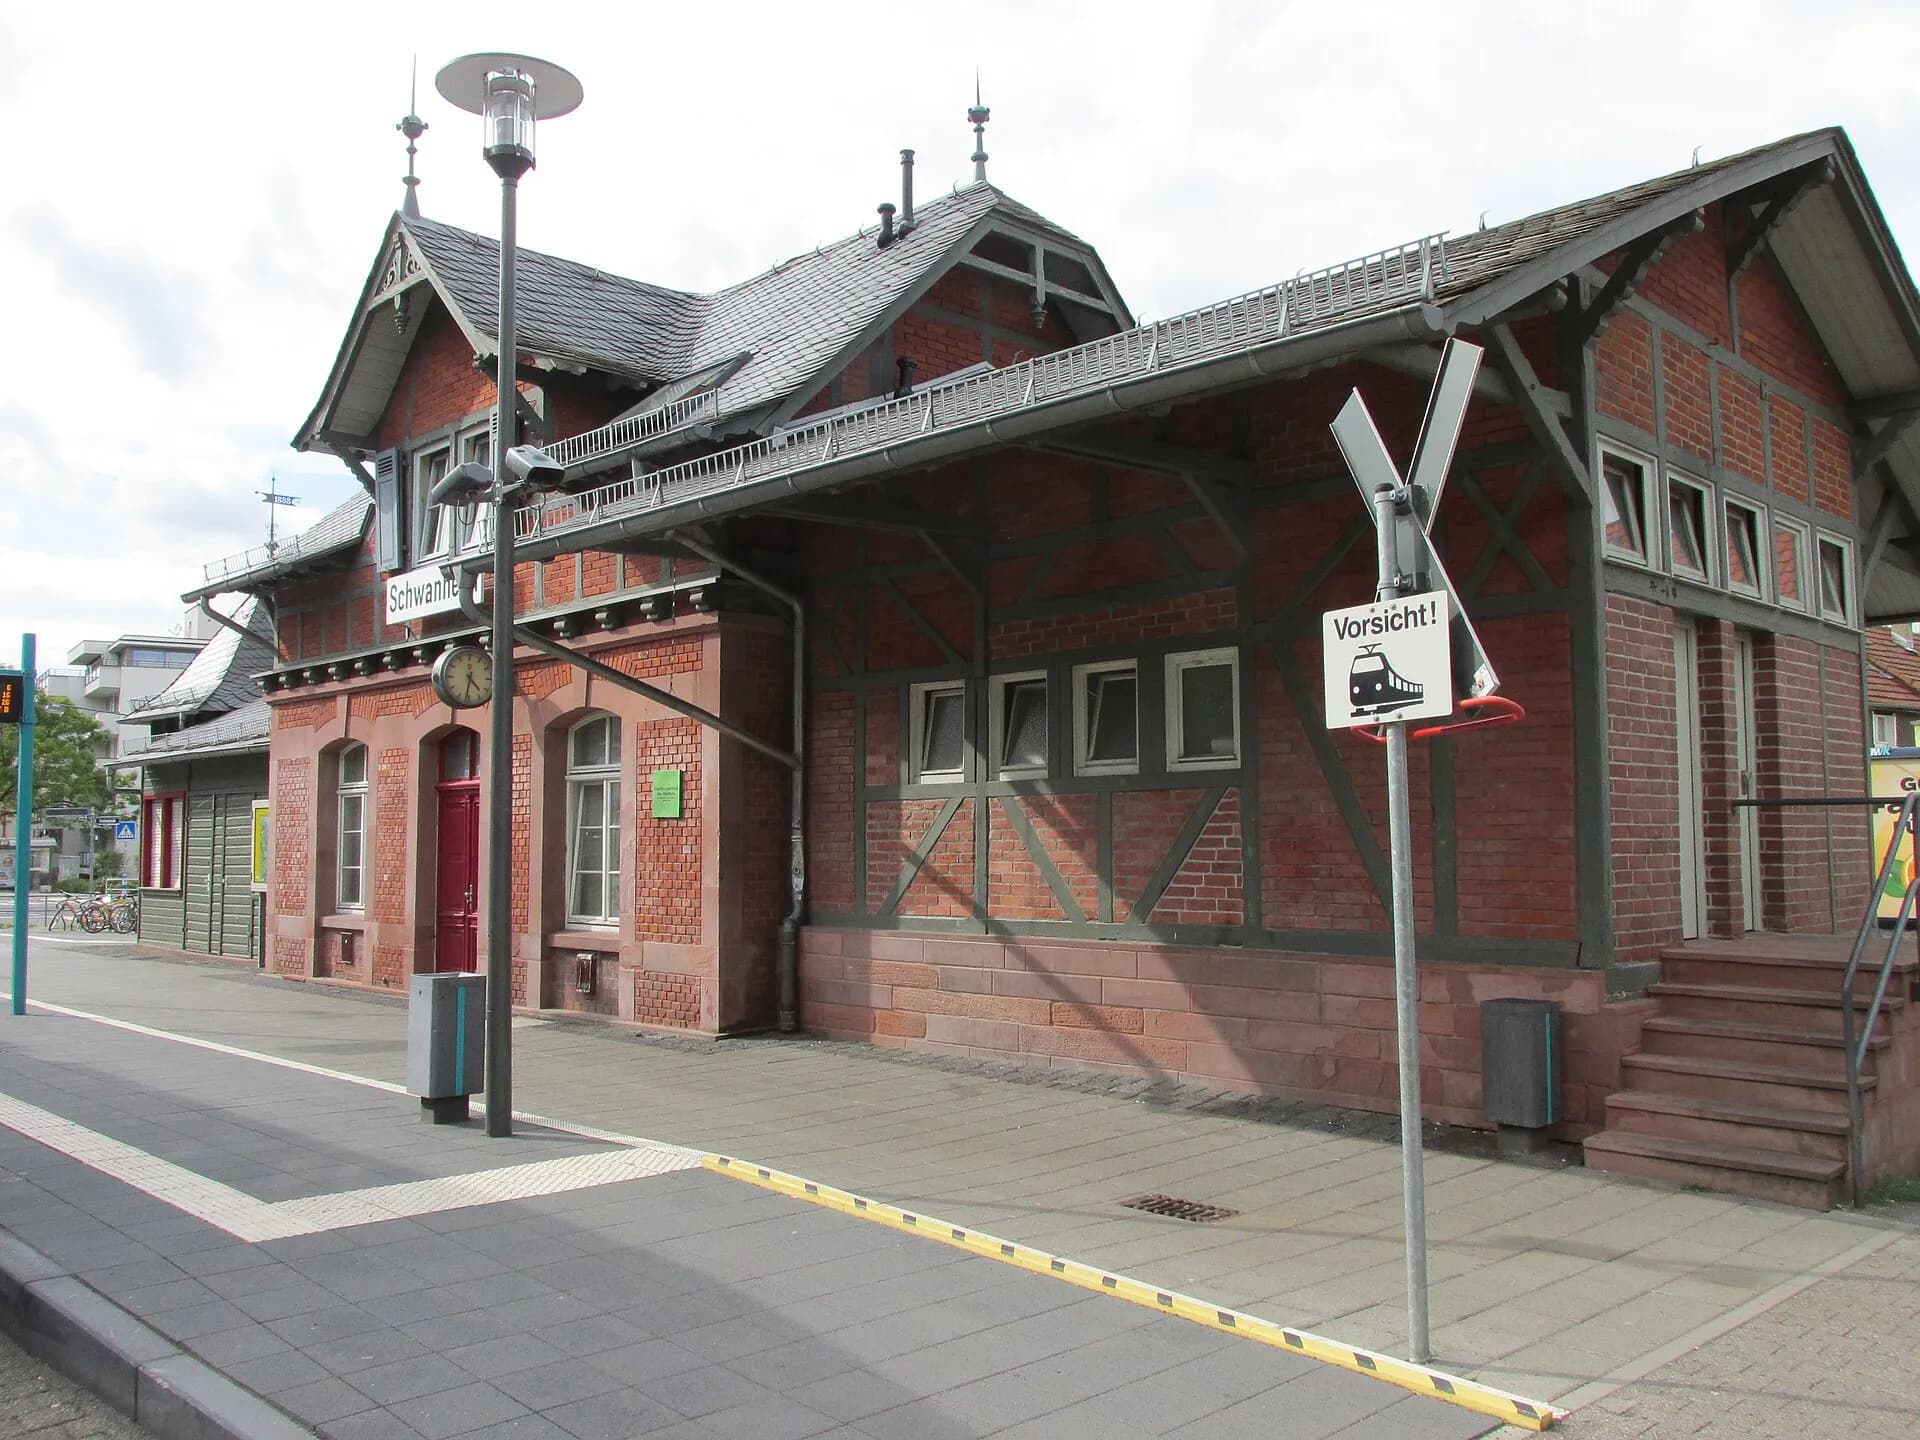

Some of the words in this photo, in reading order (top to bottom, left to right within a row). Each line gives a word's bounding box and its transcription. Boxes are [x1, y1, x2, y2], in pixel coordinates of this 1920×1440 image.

[274, 495, 291, 505] 1888
[389, 578, 472, 613] Schwanhe
[1333, 600, 1437, 641] Vorsicht!
